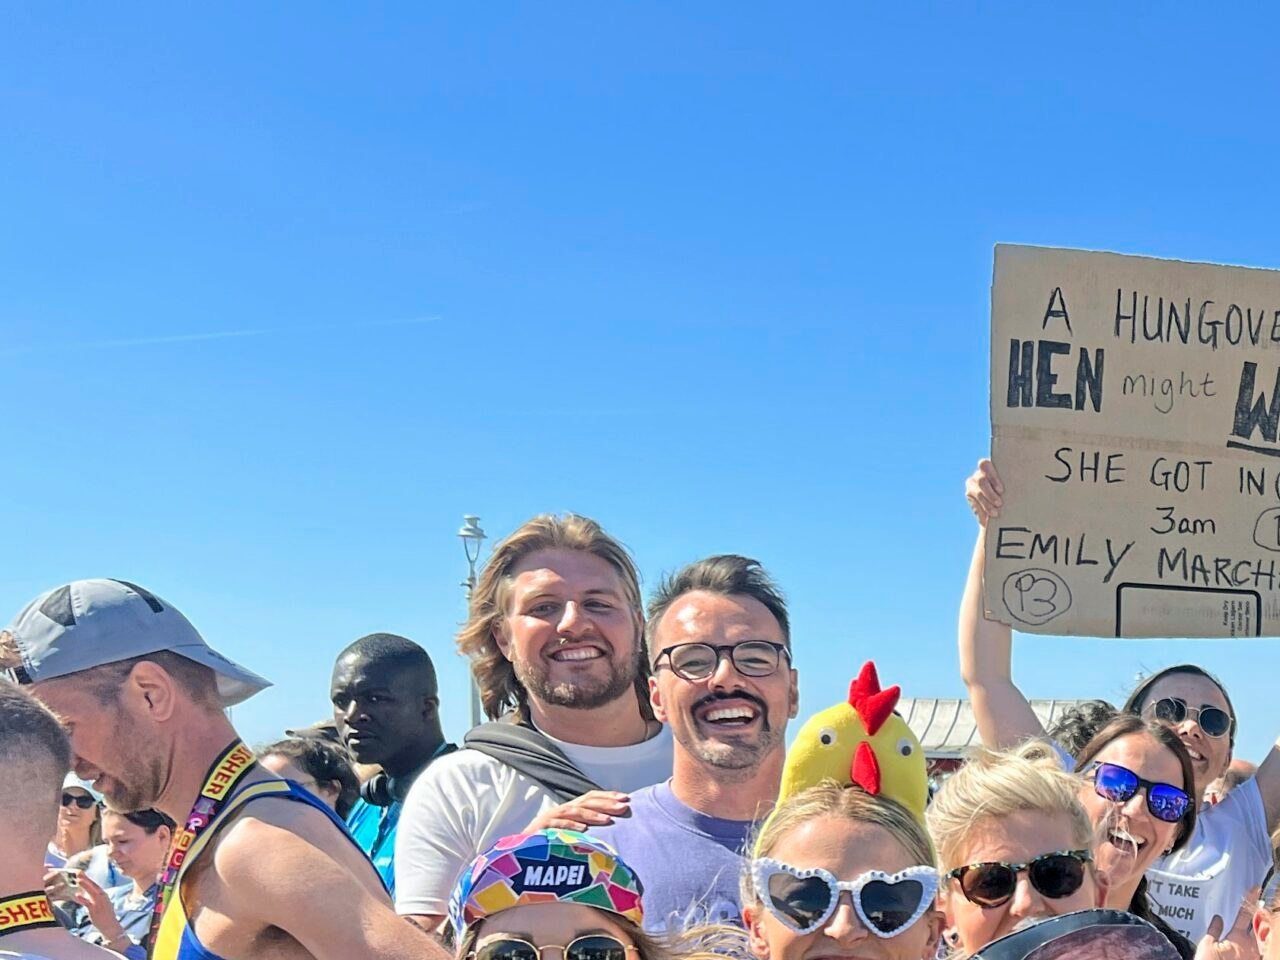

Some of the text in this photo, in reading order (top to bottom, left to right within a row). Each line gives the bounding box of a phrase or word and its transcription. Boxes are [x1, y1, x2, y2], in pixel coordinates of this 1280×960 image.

[1041, 286, 1074, 337] A
[1006, 338, 1105, 413] HEN
[1122, 371, 1218, 414] might
[1045, 447, 1127, 483] SHE
[1150, 457, 1213, 493] GOT
[1150, 506, 1217, 536] 3am
[995, 526, 1136, 584] EMILY
[523, 865, 586, 886] MAPEI
[1168, 883, 1200, 899] TAKE
[1158, 904, 1195, 921] MUCH
